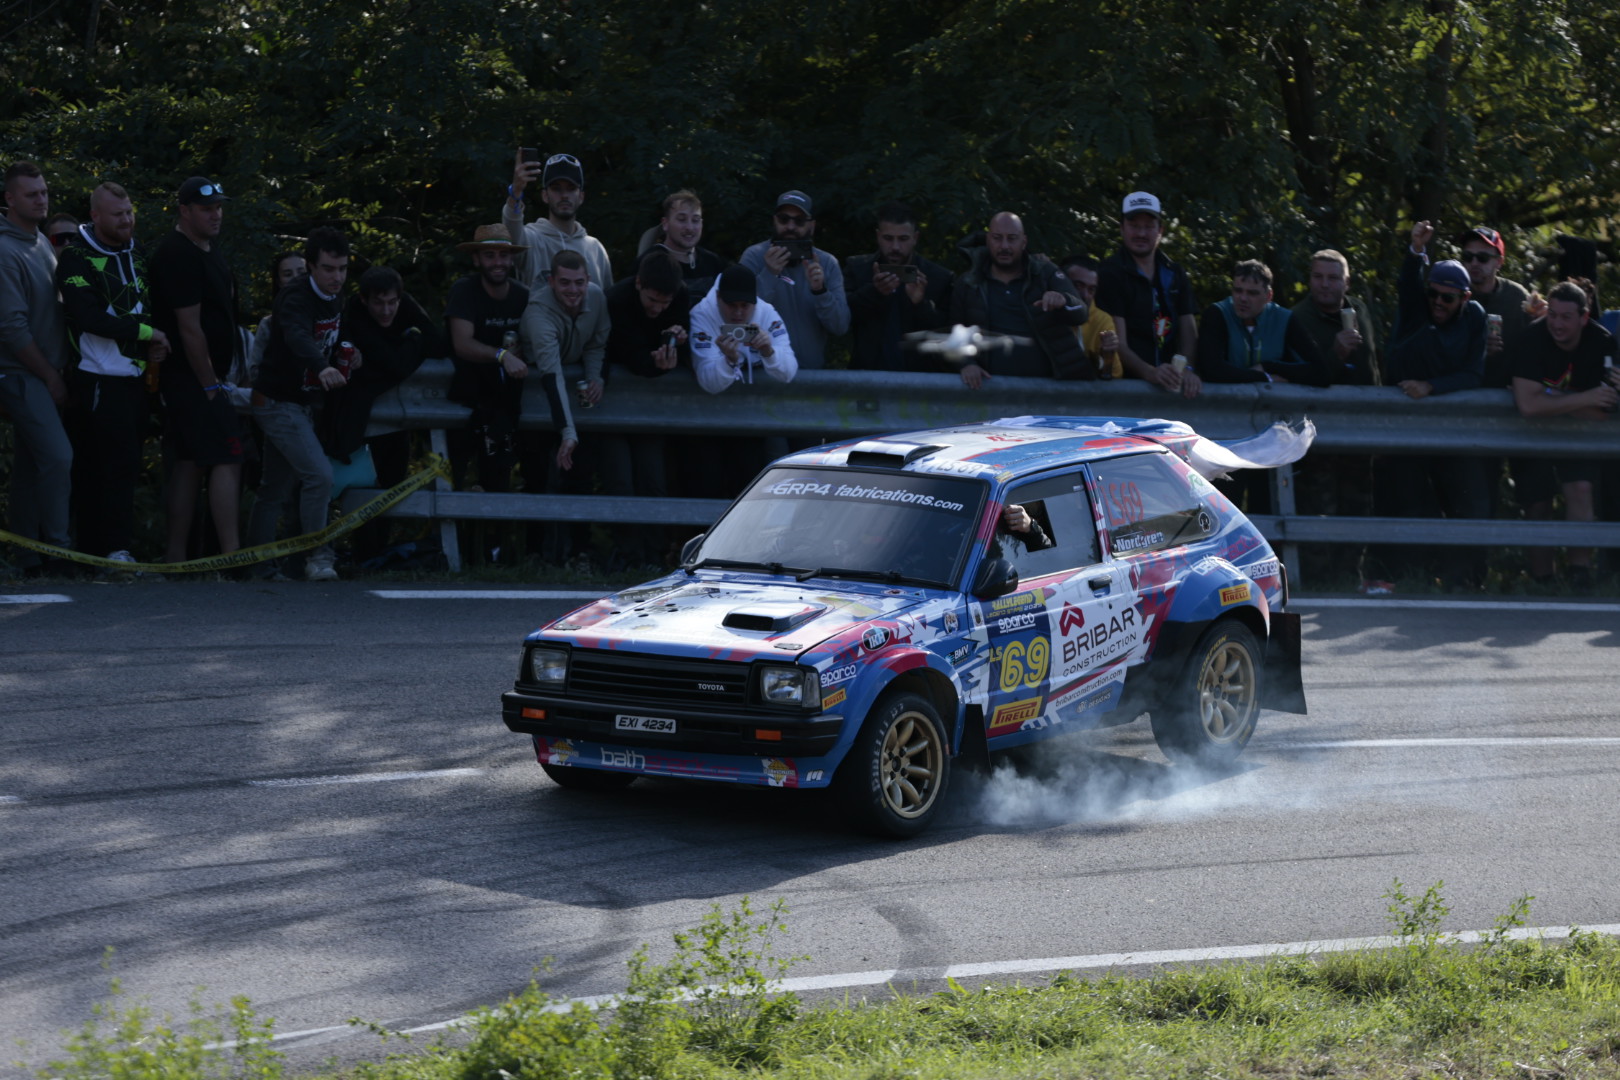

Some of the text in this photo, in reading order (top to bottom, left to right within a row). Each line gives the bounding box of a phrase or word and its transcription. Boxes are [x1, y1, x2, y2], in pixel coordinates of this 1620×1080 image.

[834, 484, 964, 511] fabrications.com
[1222, 586, 1249, 602] PIRELLI
[998, 612, 1035, 633] sparco
[1063, 607, 1135, 664] BRIBAR
[990, 636, 1050, 692] LS 69
[1063, 632, 1137, 677] CONSTRUCTION
[697, 683, 724, 691] TOYOTA
[821, 664, 857, 687] sparco
[1056, 669, 1123, 707] bribarconstruction.com
[618, 716, 674, 731] EXI 4234
[995, 701, 1038, 725] PIRELLI
